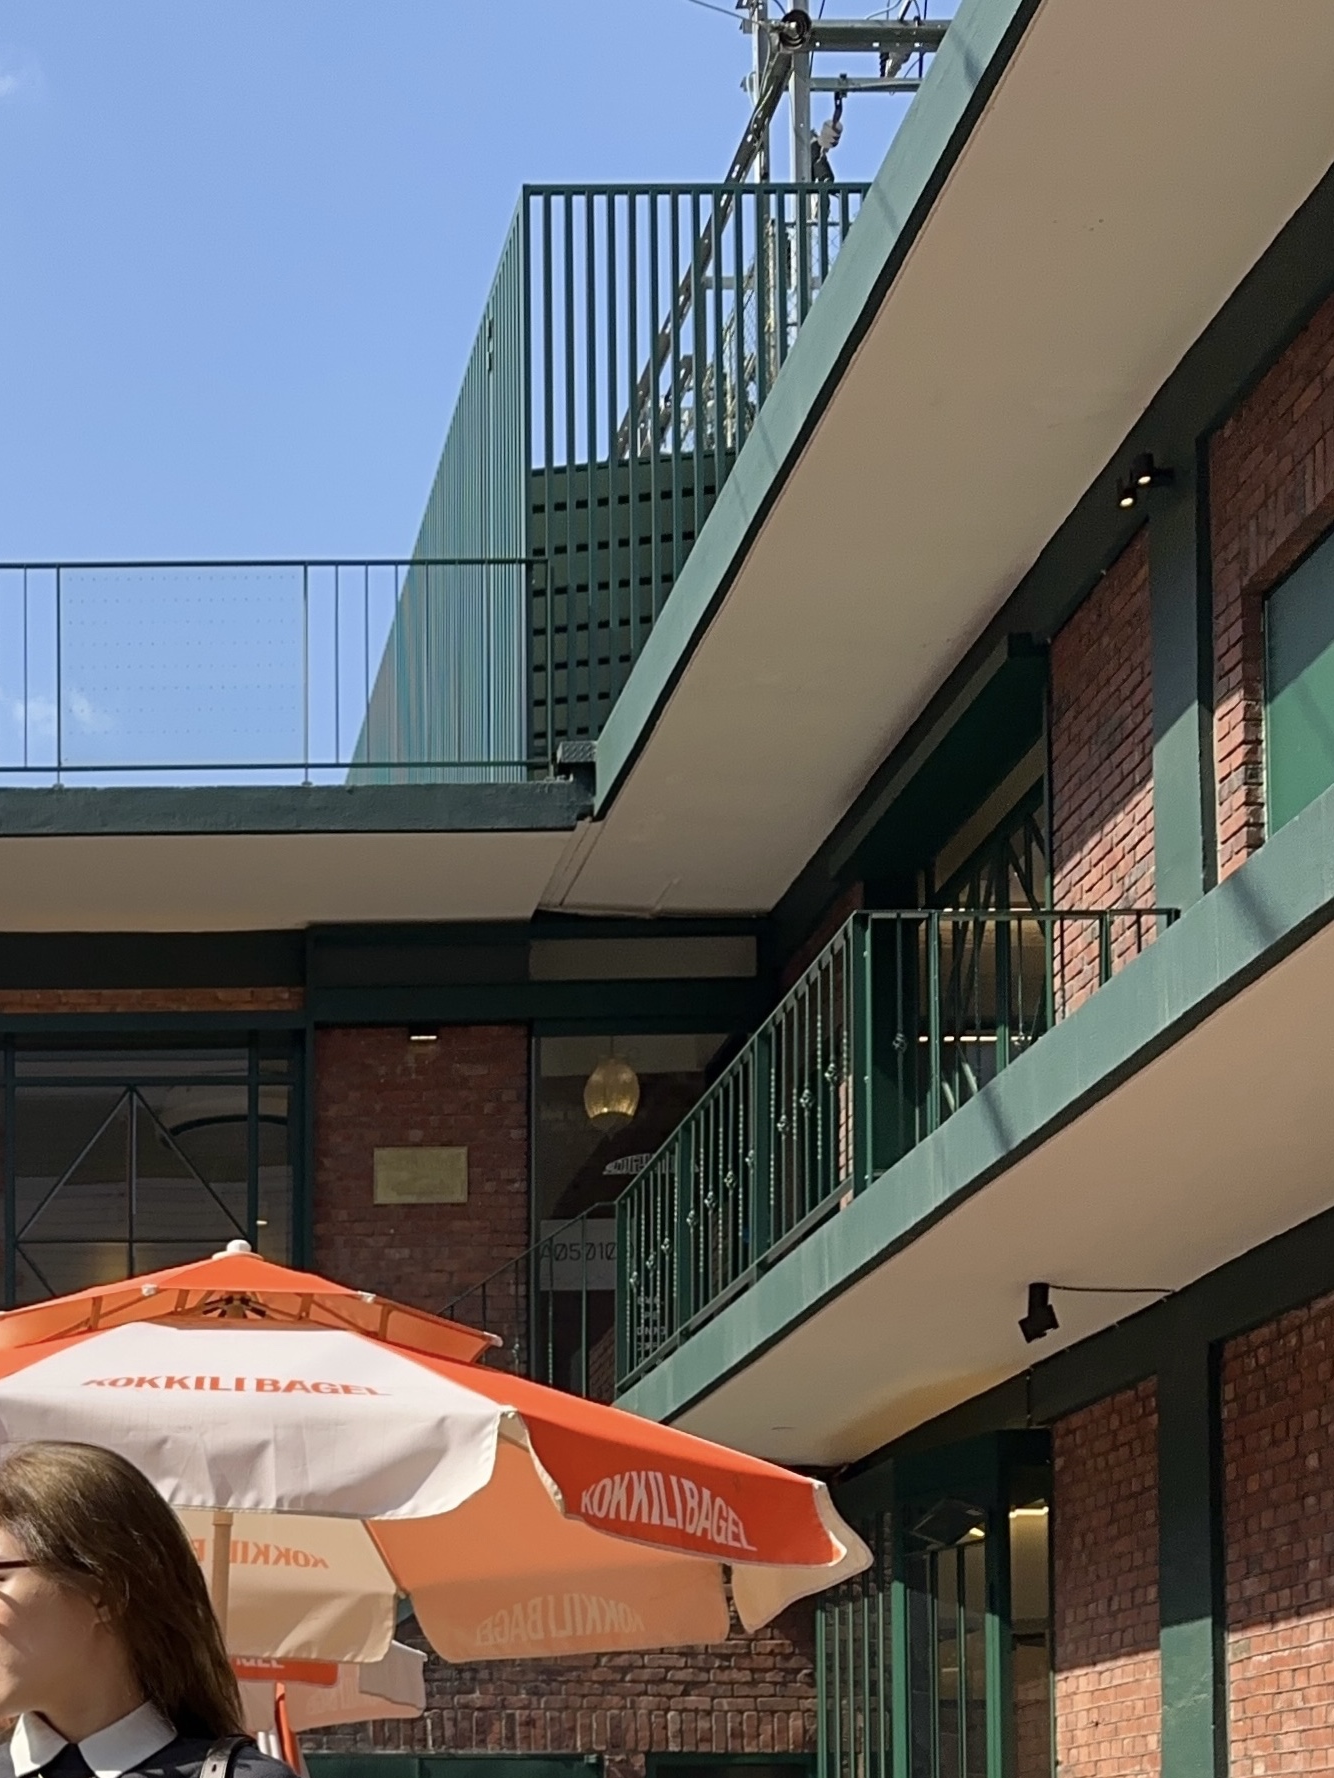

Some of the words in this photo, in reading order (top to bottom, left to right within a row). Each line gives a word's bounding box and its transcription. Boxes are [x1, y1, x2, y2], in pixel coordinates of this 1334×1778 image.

[81, 1375, 246, 1392] KOKKILI
[254, 1378, 392, 1396] BAGEL
[580, 1470, 684, 1530] KOKKILI
[681, 1478, 758, 1551] BAGEL
